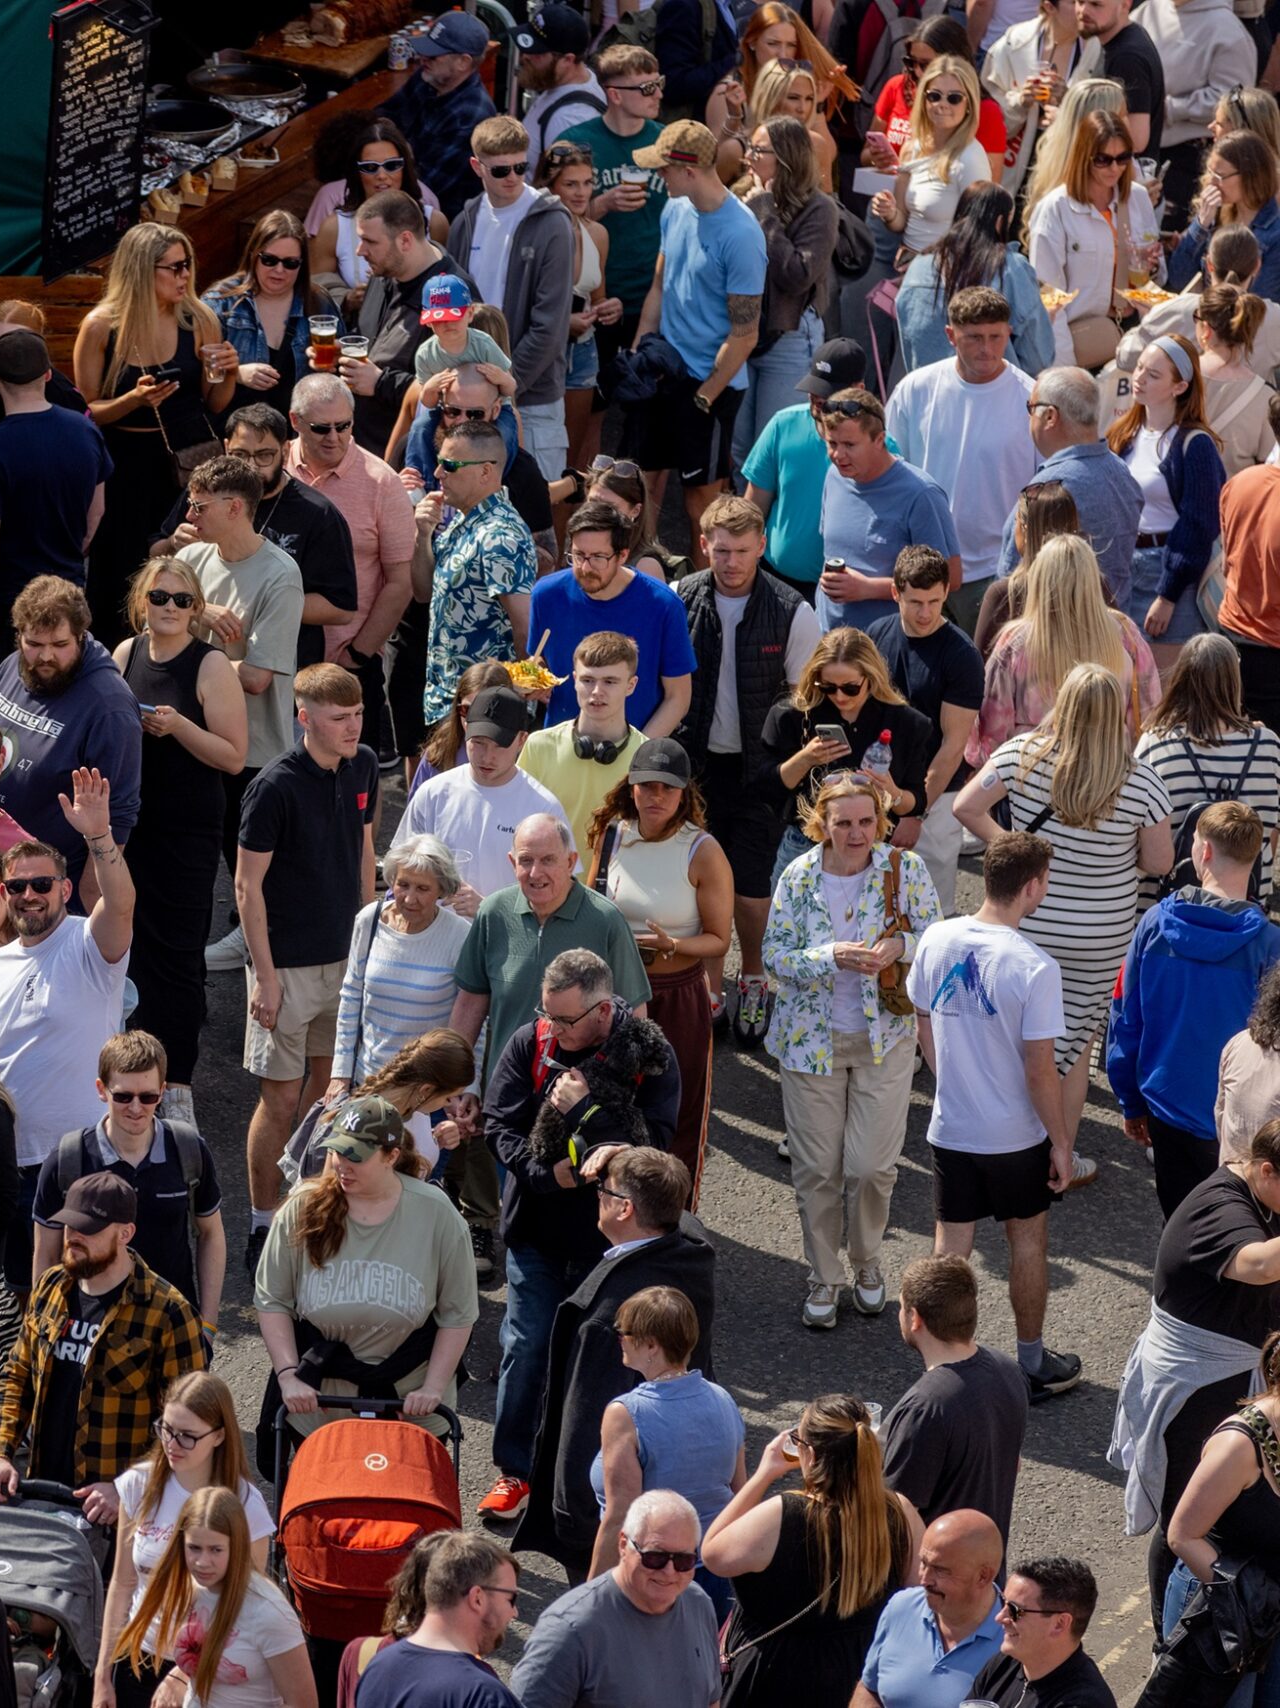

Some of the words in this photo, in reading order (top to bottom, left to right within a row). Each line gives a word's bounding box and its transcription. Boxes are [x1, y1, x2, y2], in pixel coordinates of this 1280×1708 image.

[1117, 378, 1133, 396] B
[17, 758, 33, 771] 47
[341, 1111, 360, 1131] NY
[332, 1260, 426, 1318] ANGELES
